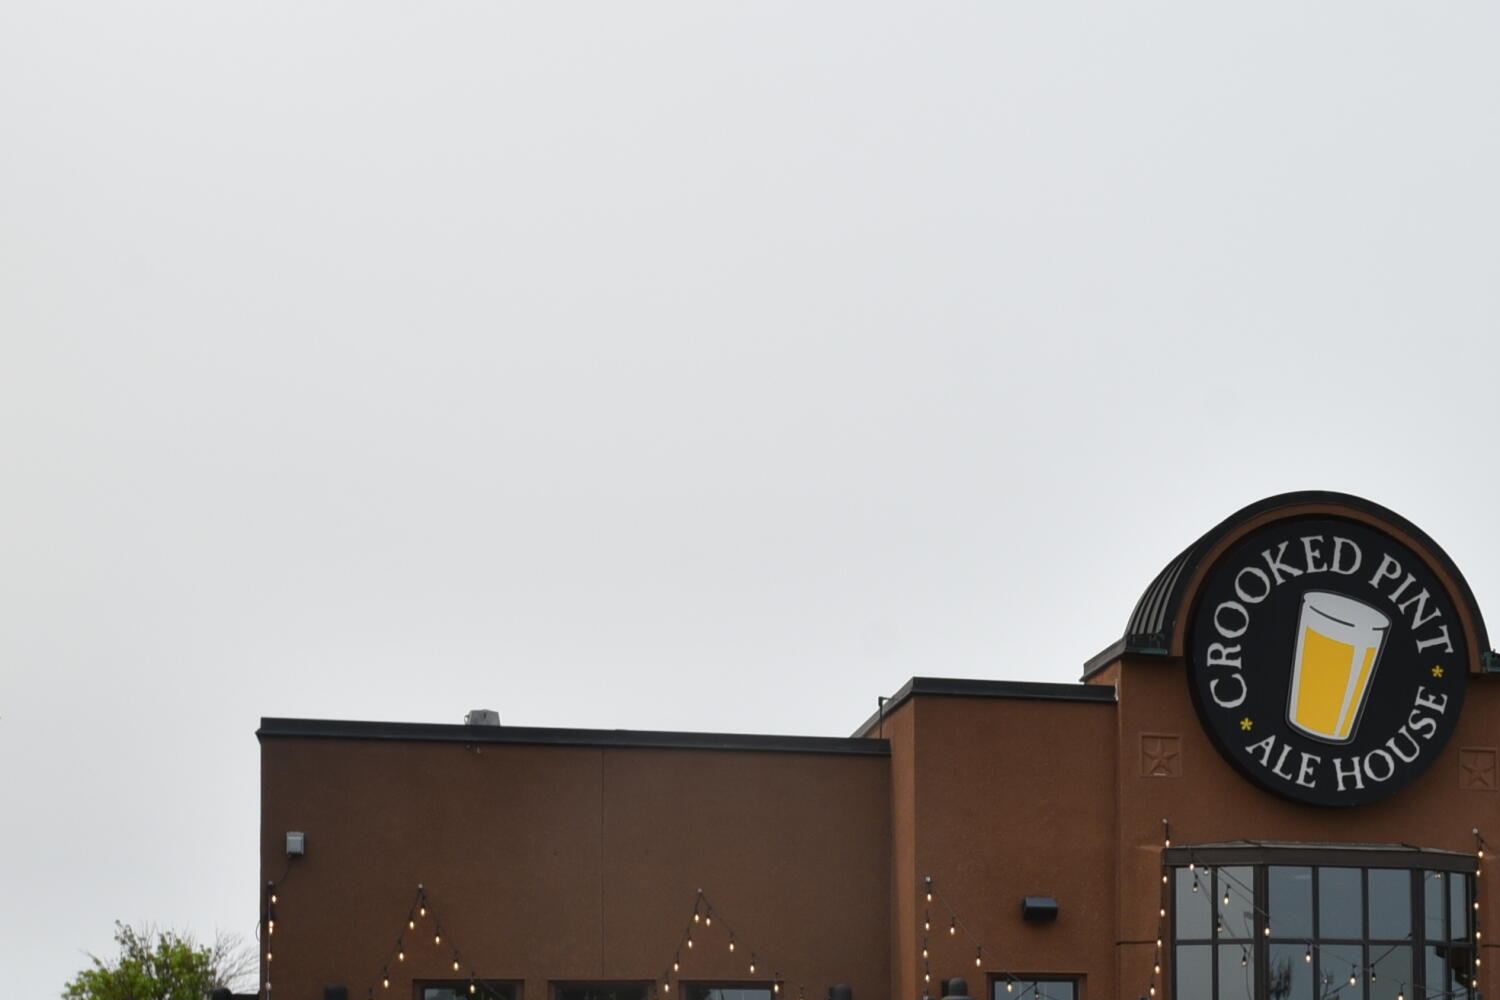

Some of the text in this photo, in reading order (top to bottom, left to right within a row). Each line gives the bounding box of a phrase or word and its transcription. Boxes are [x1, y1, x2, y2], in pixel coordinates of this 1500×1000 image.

[1206, 535, 1454, 709] CROOKED PINT
[1245, 686, 1448, 792] ALE HOUSE
